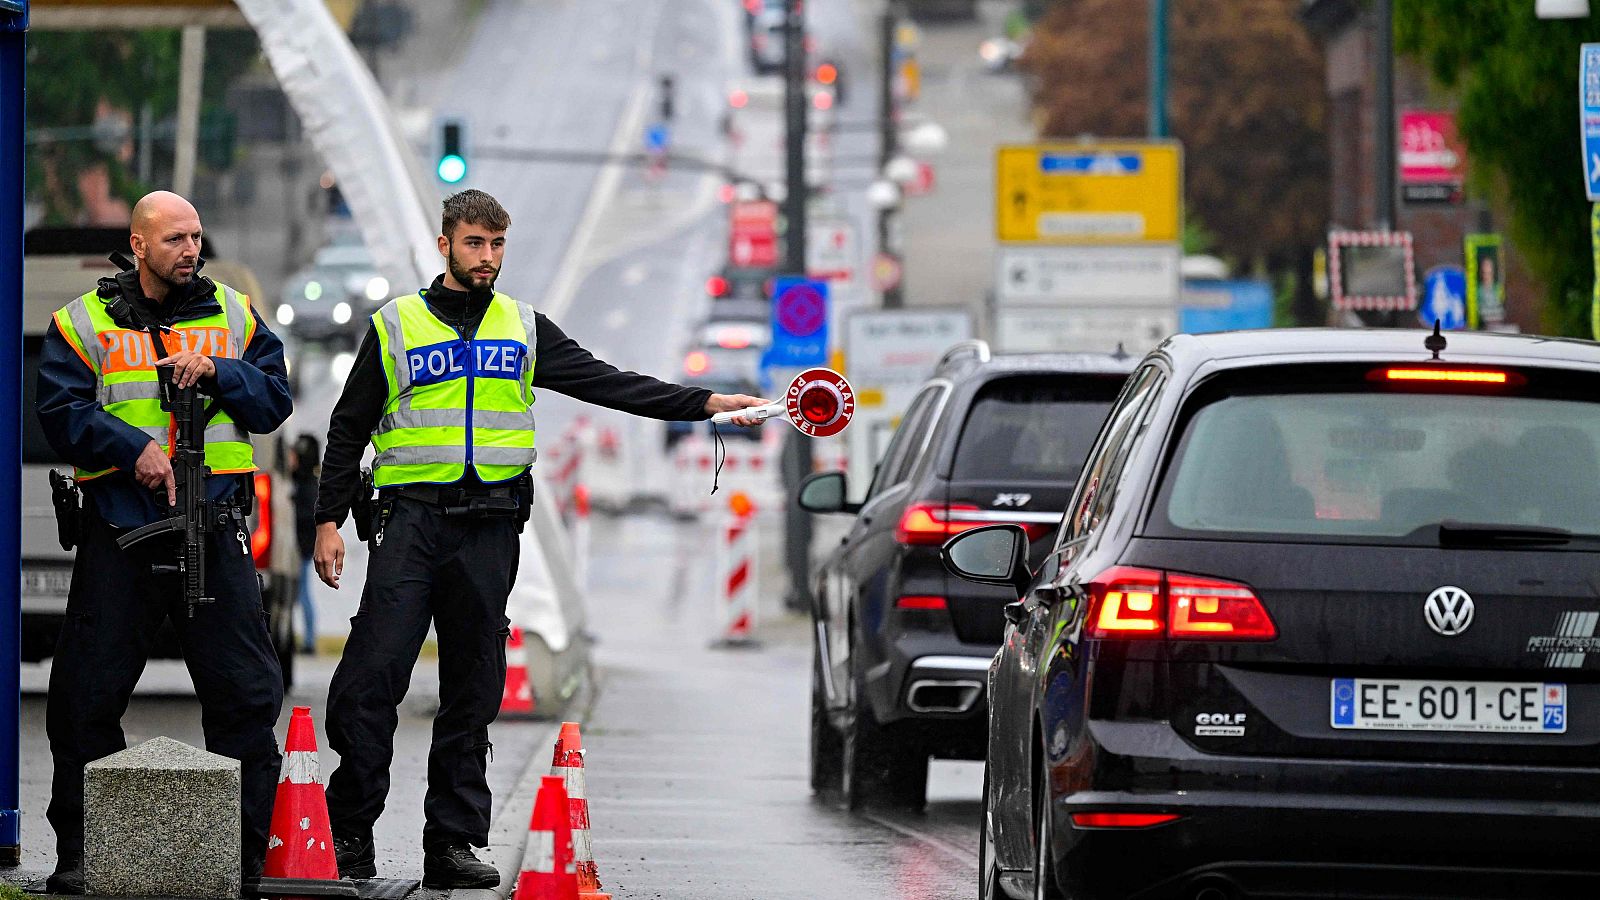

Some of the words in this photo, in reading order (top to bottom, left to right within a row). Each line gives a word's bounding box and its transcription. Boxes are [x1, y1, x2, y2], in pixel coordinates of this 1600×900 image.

[787, 376, 816, 435] POLIZEI
[835, 379, 853, 421] HALT
[992, 493, 1031, 506] X7
[1340, 704, 1349, 717] F
[1361, 684, 1538, 722] EE-601-CE
[1195, 712, 1246, 725] GOLF
[1544, 707, 1563, 725] 75
